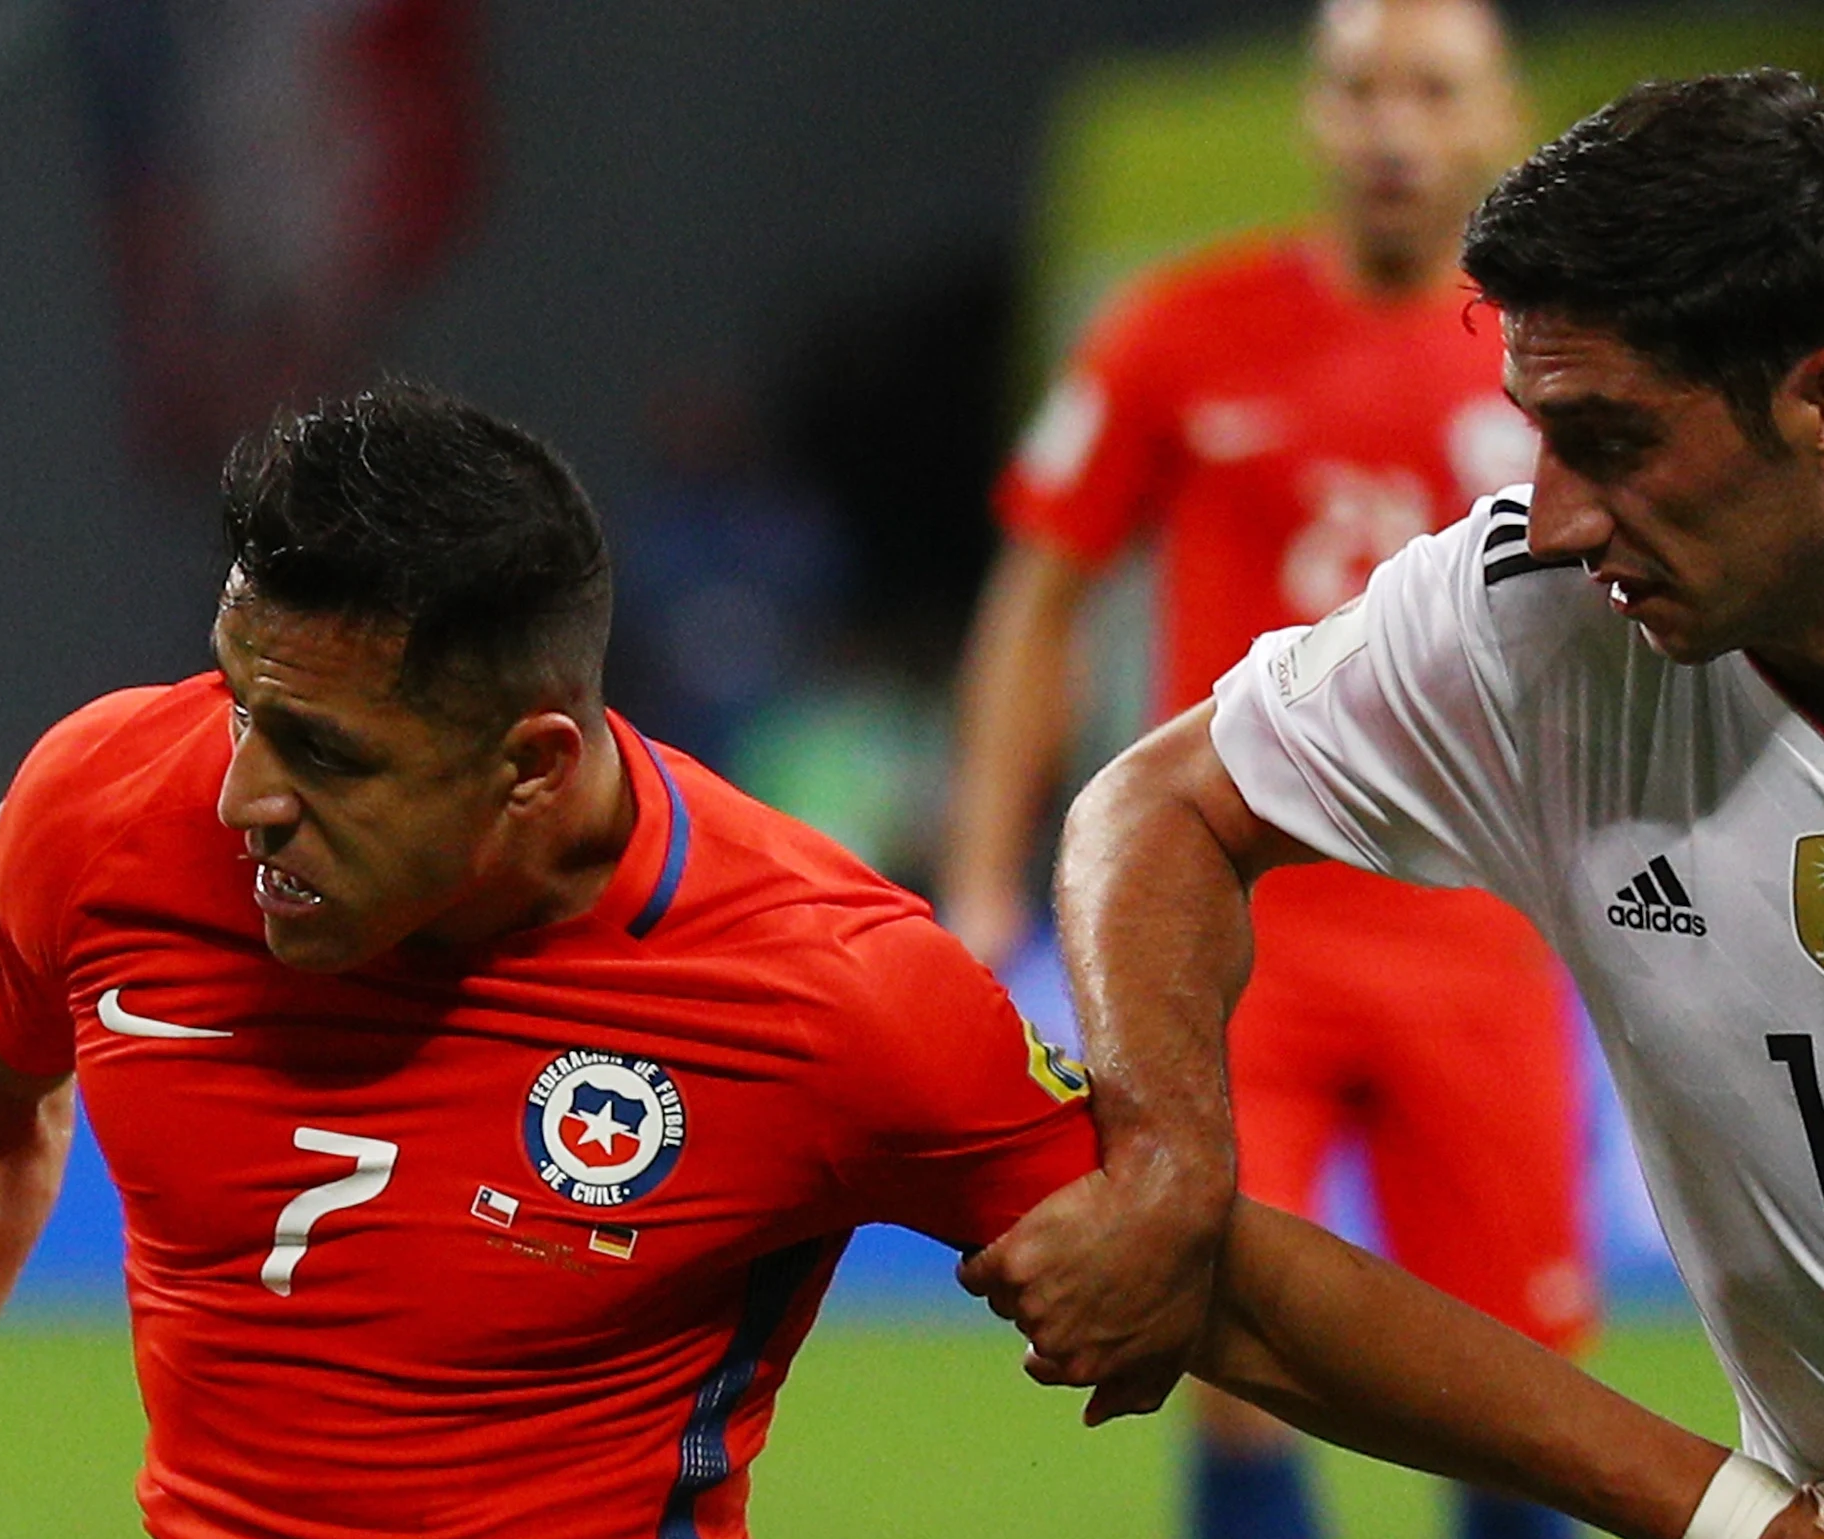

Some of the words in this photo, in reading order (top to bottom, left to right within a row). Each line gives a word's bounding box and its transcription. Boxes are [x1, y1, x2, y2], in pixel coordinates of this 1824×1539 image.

[1607, 900, 1707, 937] adidas
[540, 1163, 568, 1191] DE
[571, 1182, 624, 1206] CHILE
[261, 1126, 399, 1297] 7
